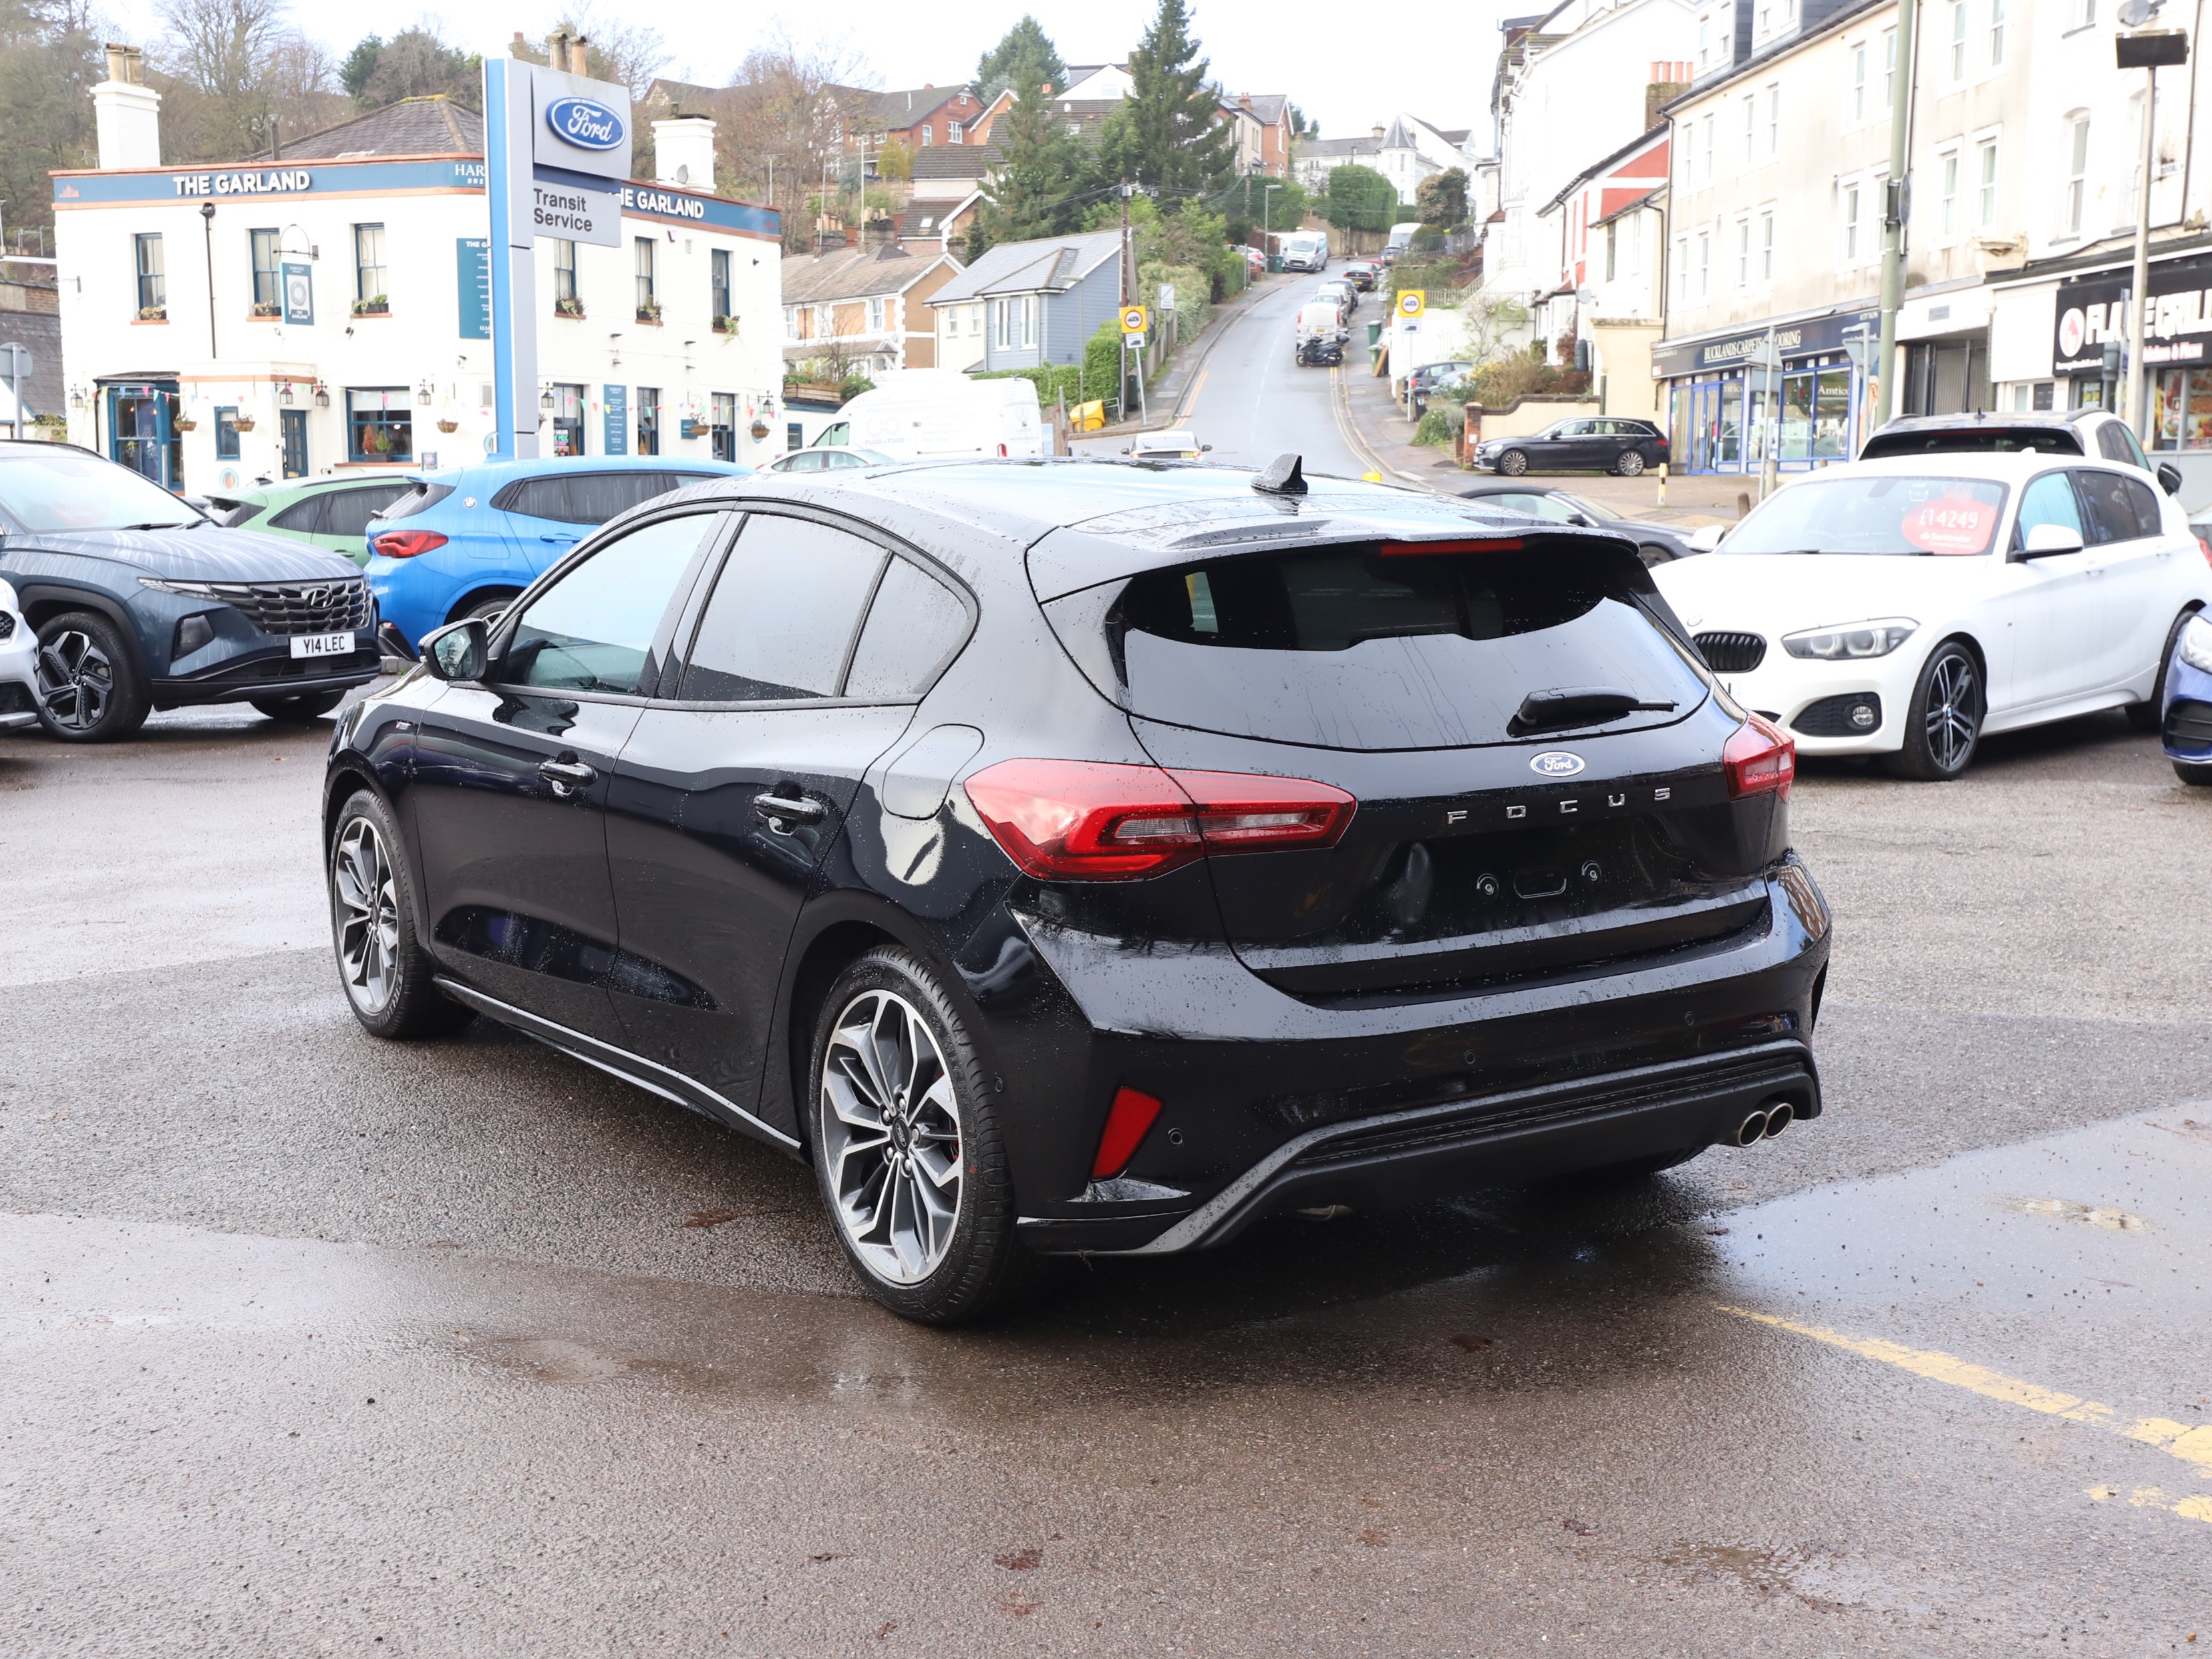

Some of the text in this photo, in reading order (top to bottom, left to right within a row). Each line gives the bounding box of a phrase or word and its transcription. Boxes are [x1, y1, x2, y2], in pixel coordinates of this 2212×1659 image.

[568, 105, 613, 142] Ford
[455, 164, 485, 176] HAR
[173, 171, 310, 195] THE GARLAND
[533, 188, 587, 212] Transit
[637, 191, 704, 218] GARLAND
[534, 208, 593, 232] Service
[2085, 297, 2156, 345] FLAE
[1704, 341, 1738, 361] BUCKLANDS
[1775, 329, 1801, 348] OORING
[1919, 508, 1978, 529] £14249
[303, 635, 345, 653] Y14 LEC
[1544, 756, 1574, 771] Ford
[1447, 787, 1670, 824] FOCUS
